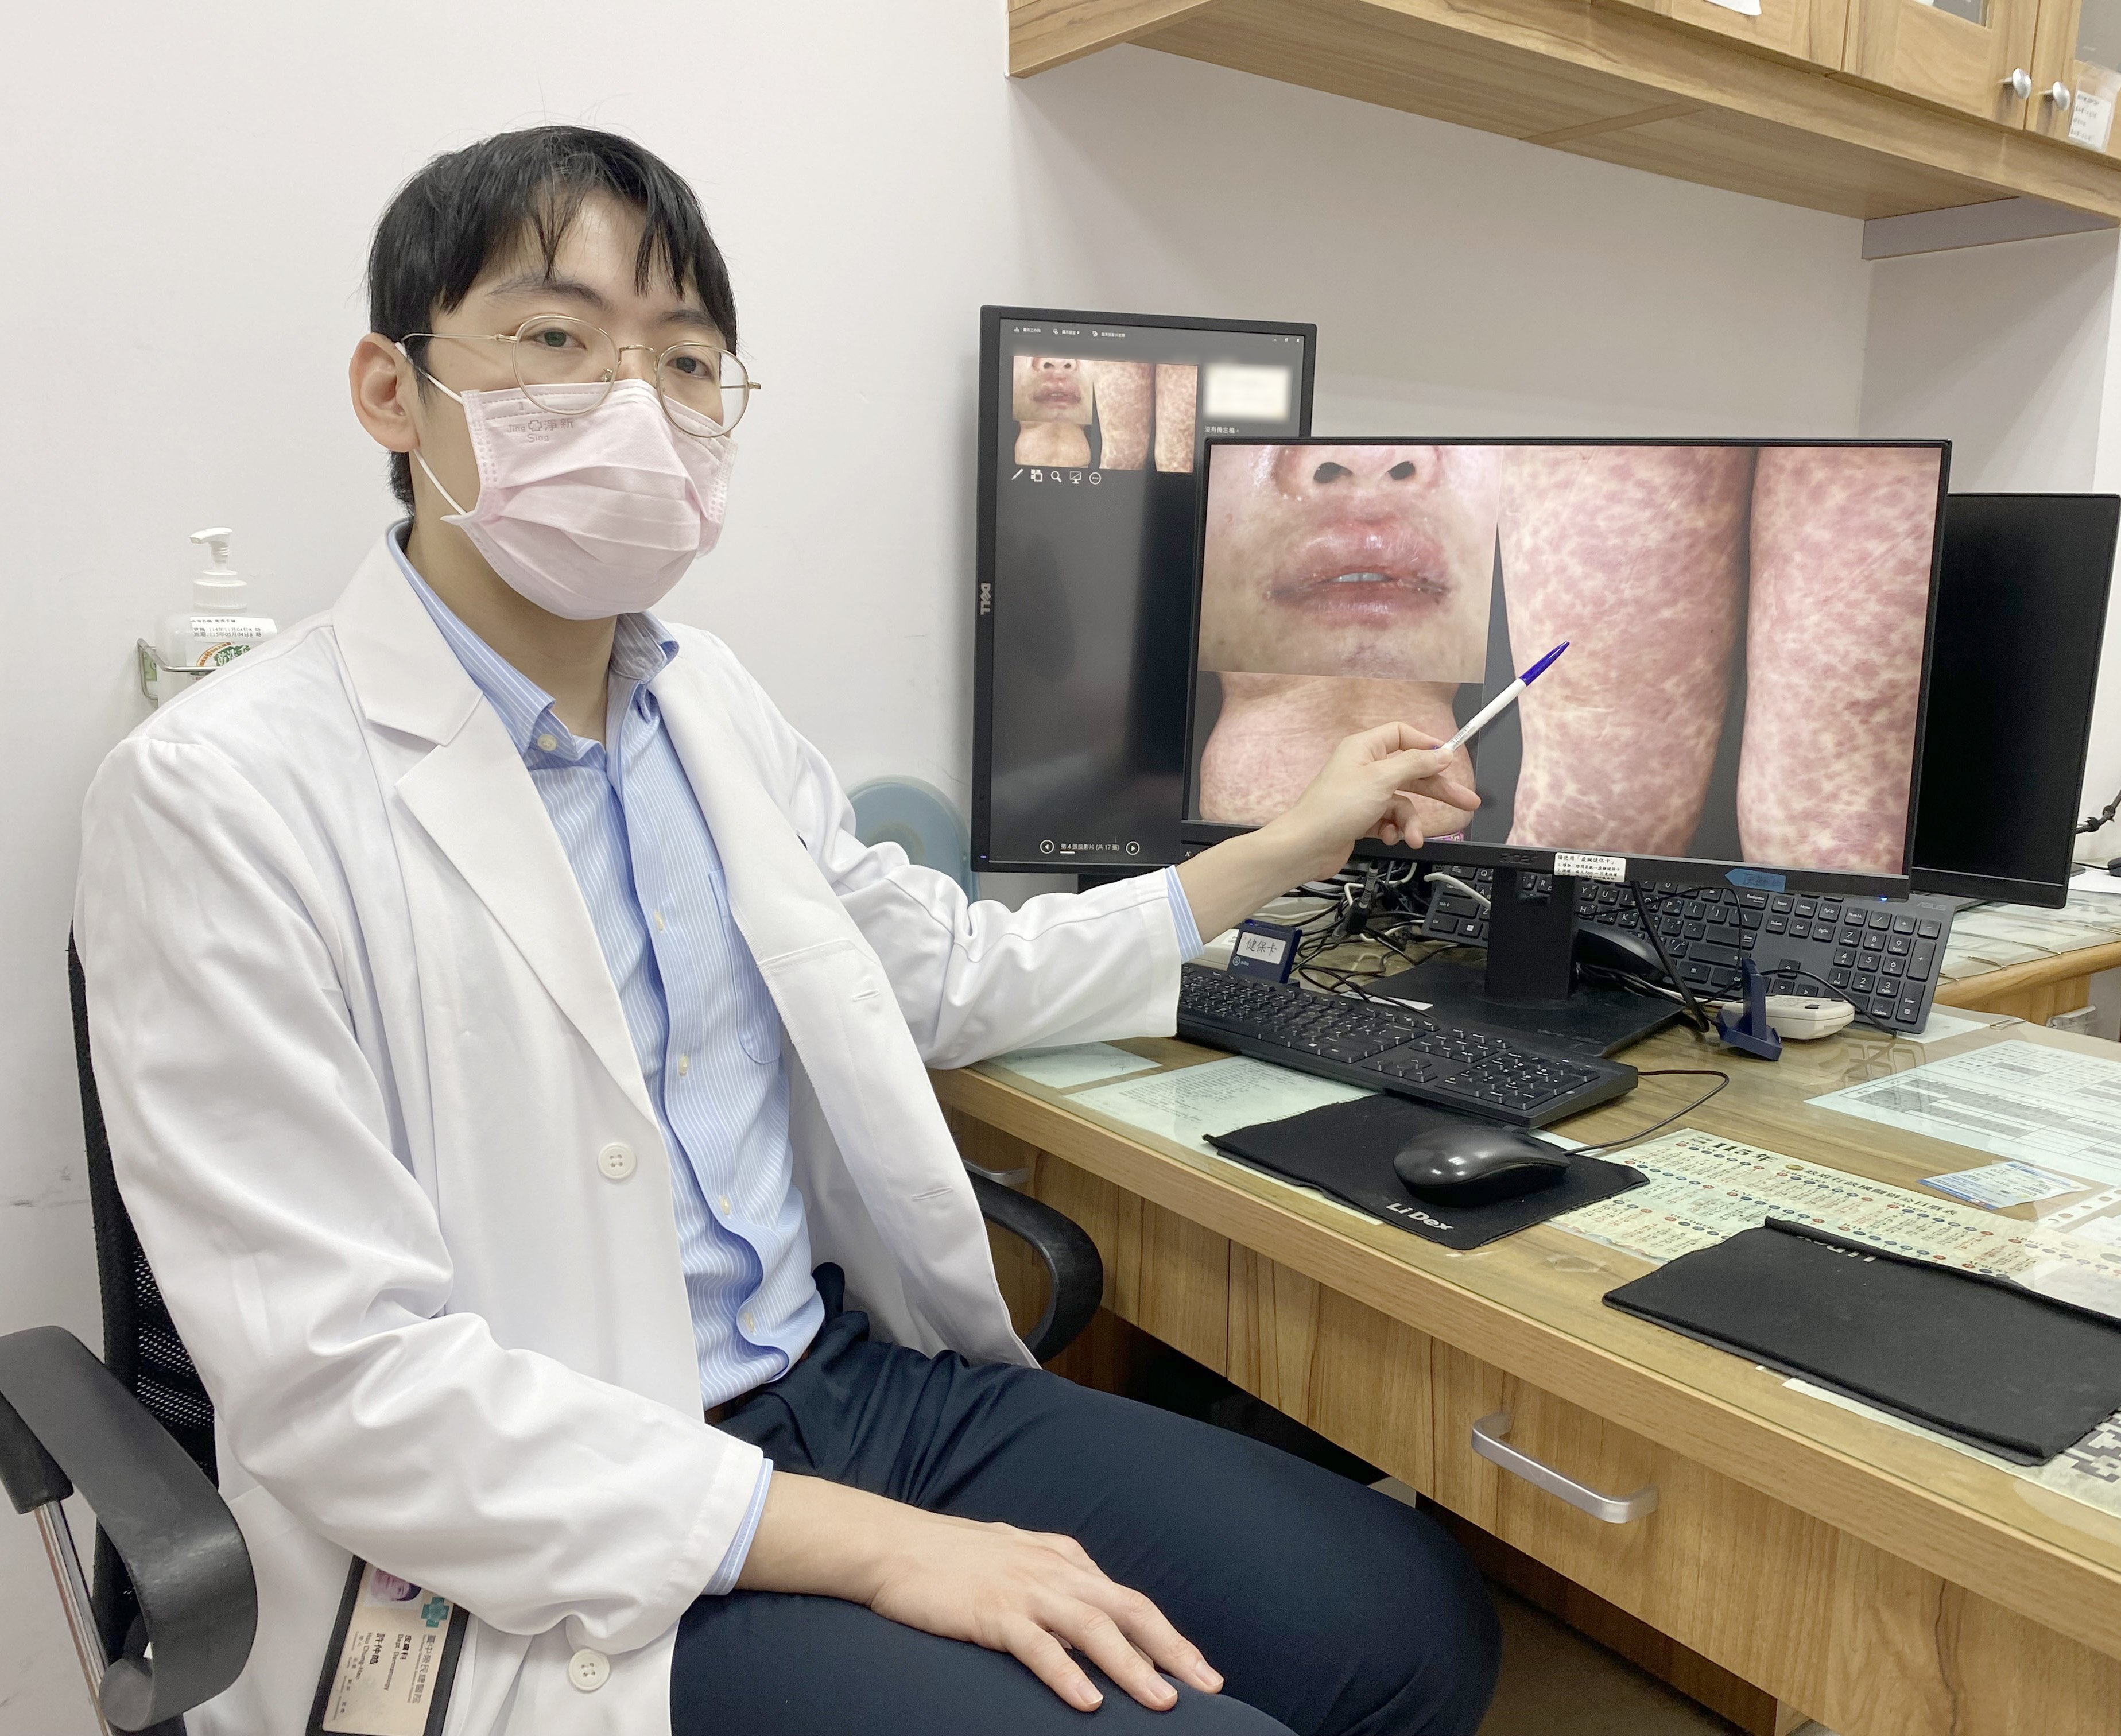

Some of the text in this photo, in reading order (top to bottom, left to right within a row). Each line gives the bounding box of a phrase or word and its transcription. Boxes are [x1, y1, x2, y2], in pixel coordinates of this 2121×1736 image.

[527, 433, 549, 443] Sing
[980, 583, 991, 615] DELL
[1916, 902, 1946, 911] ASUS
[1246, 939, 1277, 956] 健保卡
[400, 1634, 412, 1660] 皮膚科
